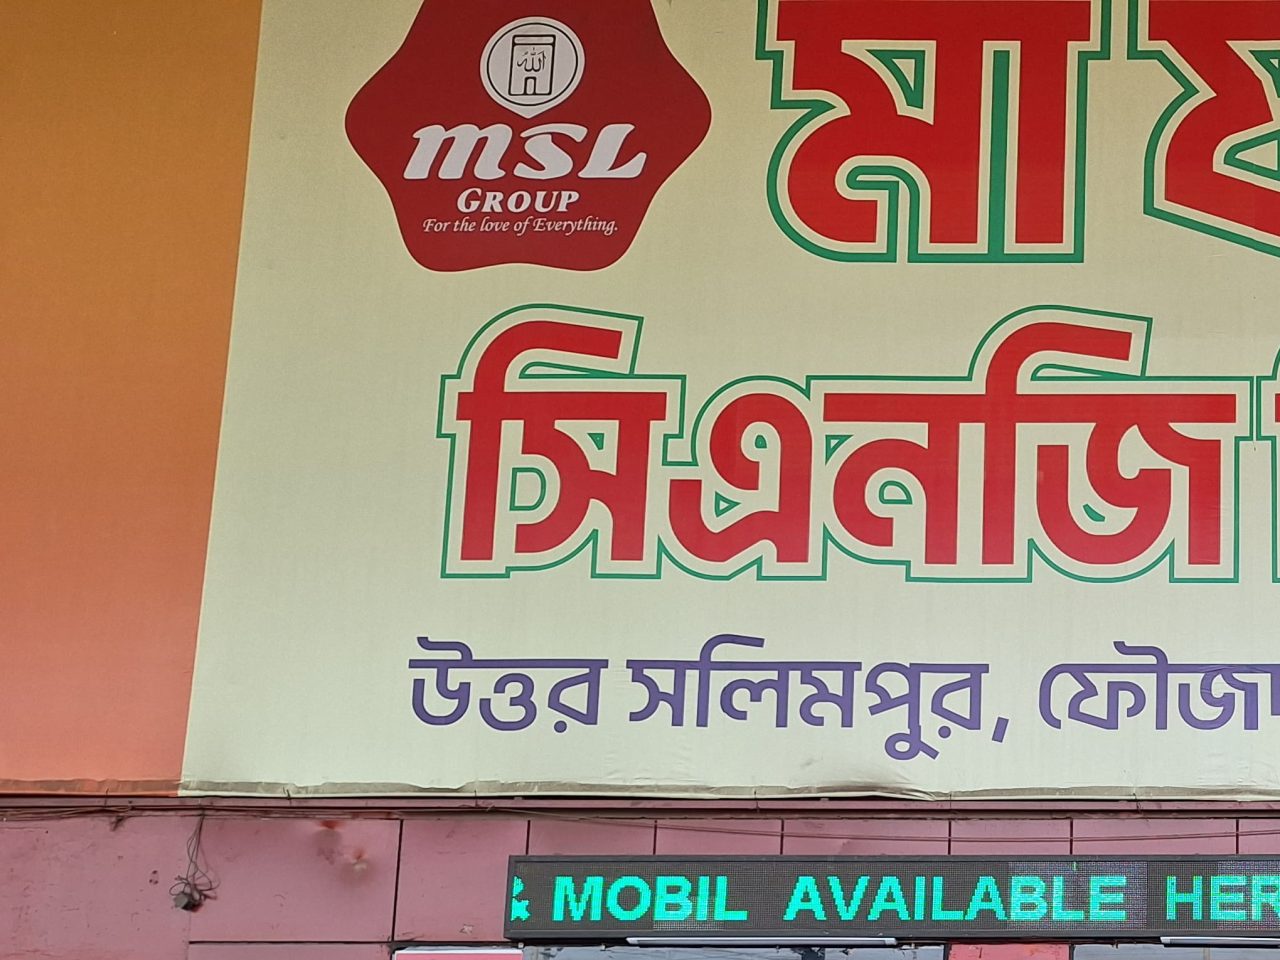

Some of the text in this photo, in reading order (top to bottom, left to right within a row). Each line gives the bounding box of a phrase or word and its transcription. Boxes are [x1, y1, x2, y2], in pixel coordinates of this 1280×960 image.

[775, 0, 1092, 244] মা
[422, 215, 618, 237] For the love of Everything.
[457, 187, 580, 213] GROUP
[456, 320, 1238, 566] সিএনজি
[409, 637, 610, 734] উত্তর
[627, 634, 1008, 761] সলিমপুর,
[553, 876, 748, 921] MOBIL
[783, 876, 1127, 921] AVAILABLE
